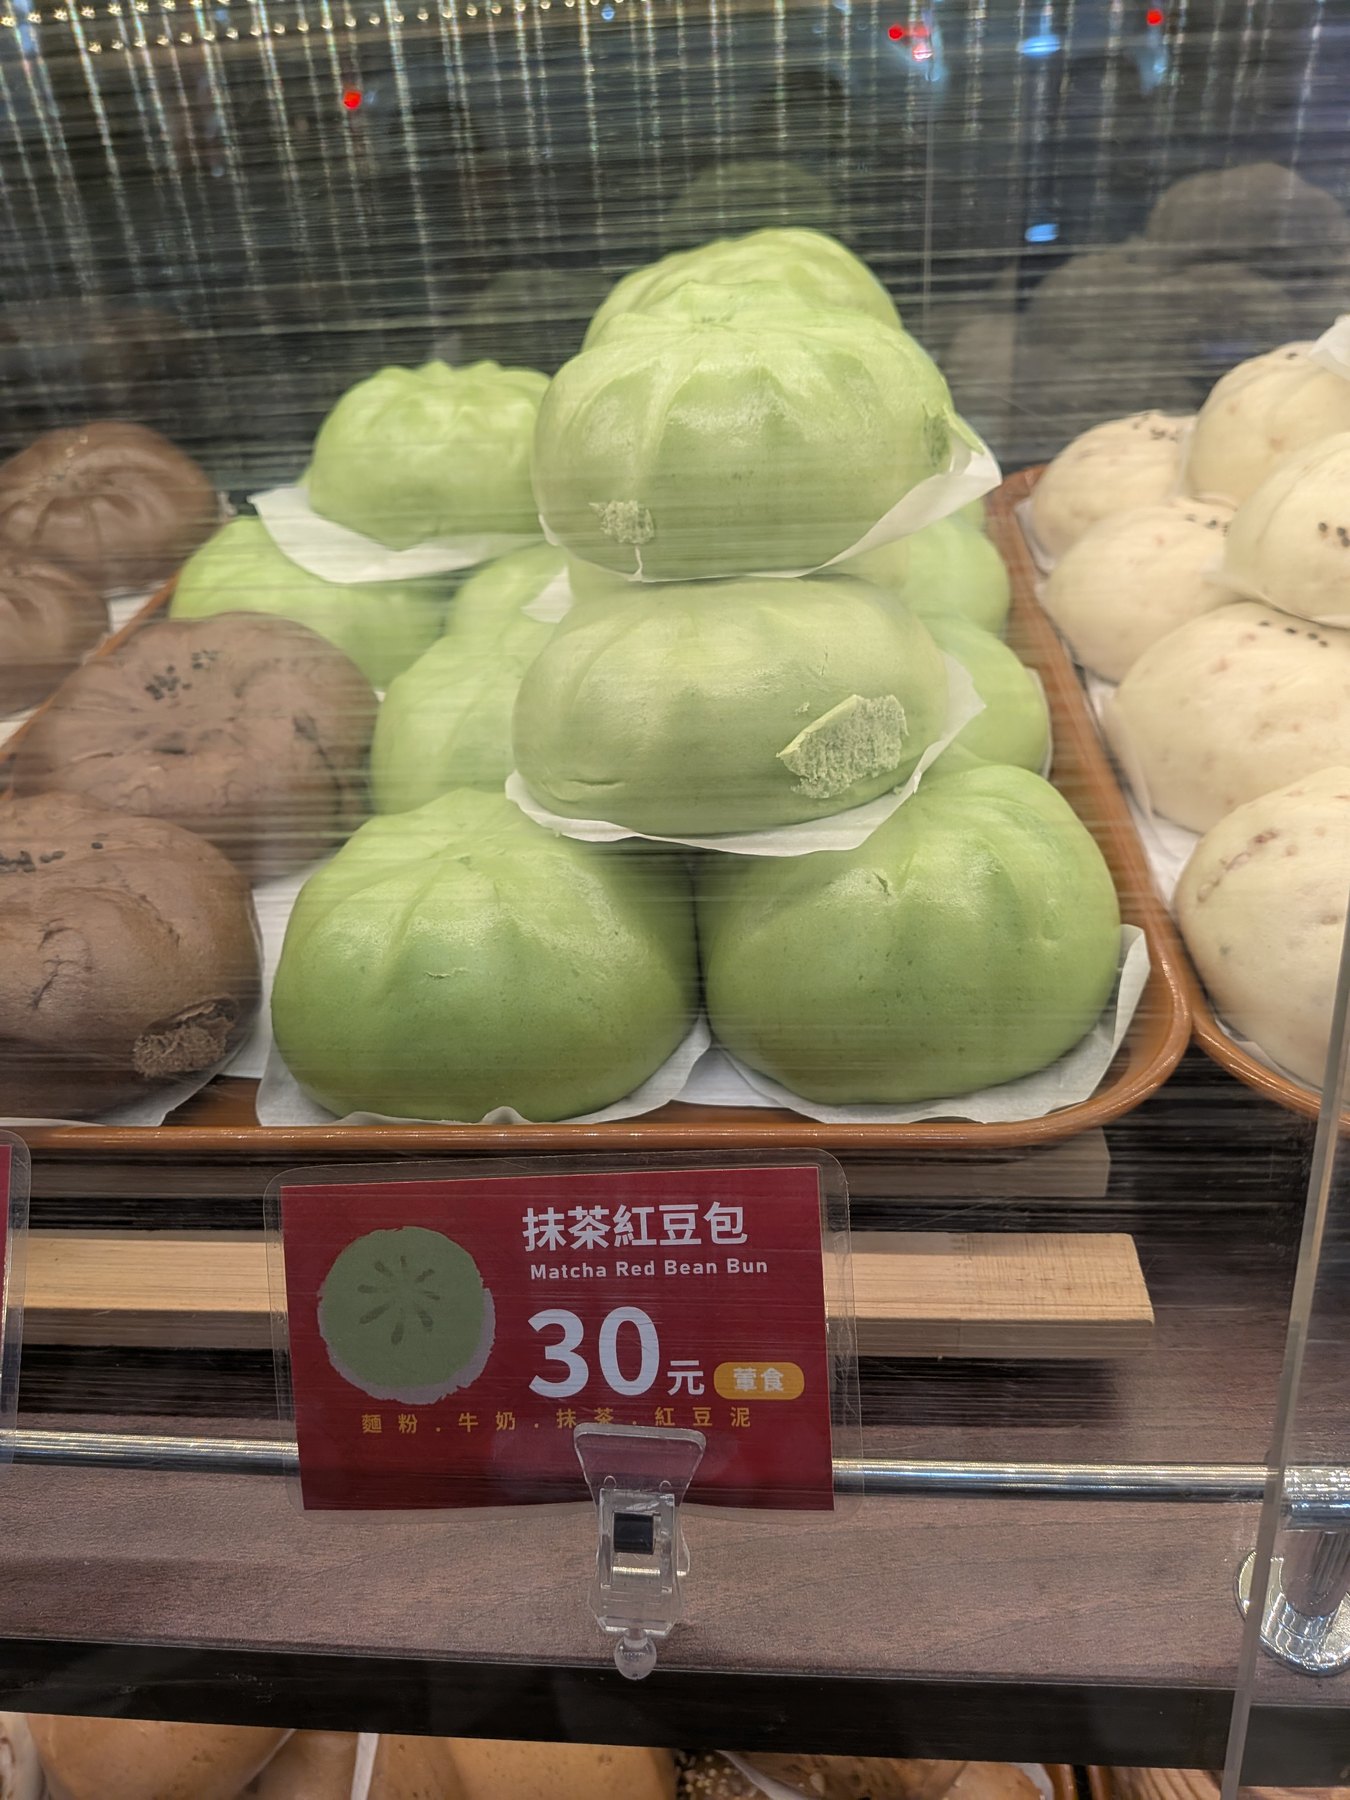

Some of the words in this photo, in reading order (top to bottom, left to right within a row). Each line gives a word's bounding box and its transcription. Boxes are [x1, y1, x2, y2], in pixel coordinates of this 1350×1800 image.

[522, 1201, 748, 1252] 抹茶紅豆包
[530, 1263, 607, 1280] Matcha
[616, 1261, 655, 1277] Red
[664, 1259, 717, 1275] Bean
[726, 1257, 768, 1274] Bun
[733, 1367, 784, 1392] 葷食
